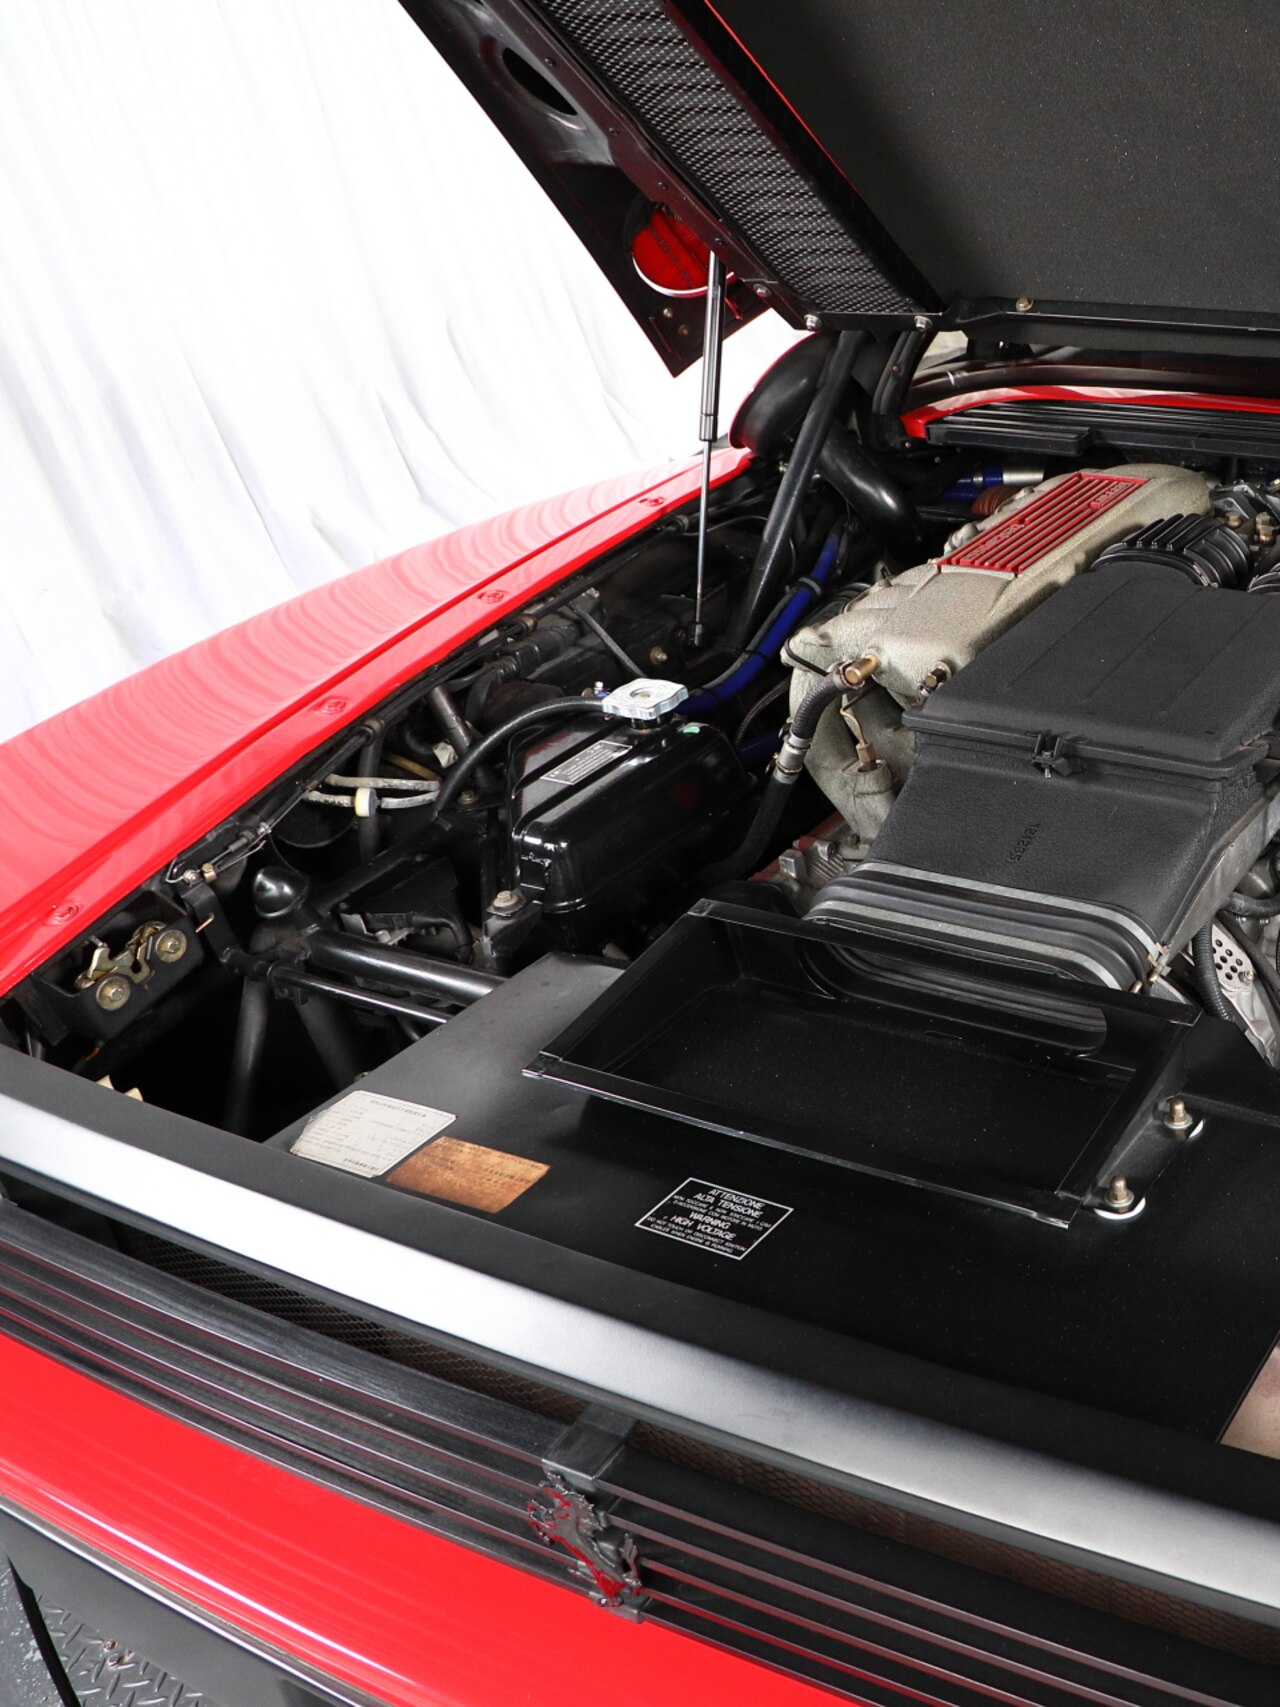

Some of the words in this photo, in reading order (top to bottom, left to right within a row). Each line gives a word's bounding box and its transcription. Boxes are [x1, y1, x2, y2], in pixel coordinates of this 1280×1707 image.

[708, 1189, 765, 1210] ATTENZIONE
[717, 1200, 764, 1218] TENSIONE
[670, 1215, 694, 1227] HIGH
[697, 1223, 736, 1241] VOLTAGE
[689, 1211, 731, 1229] WARNING
